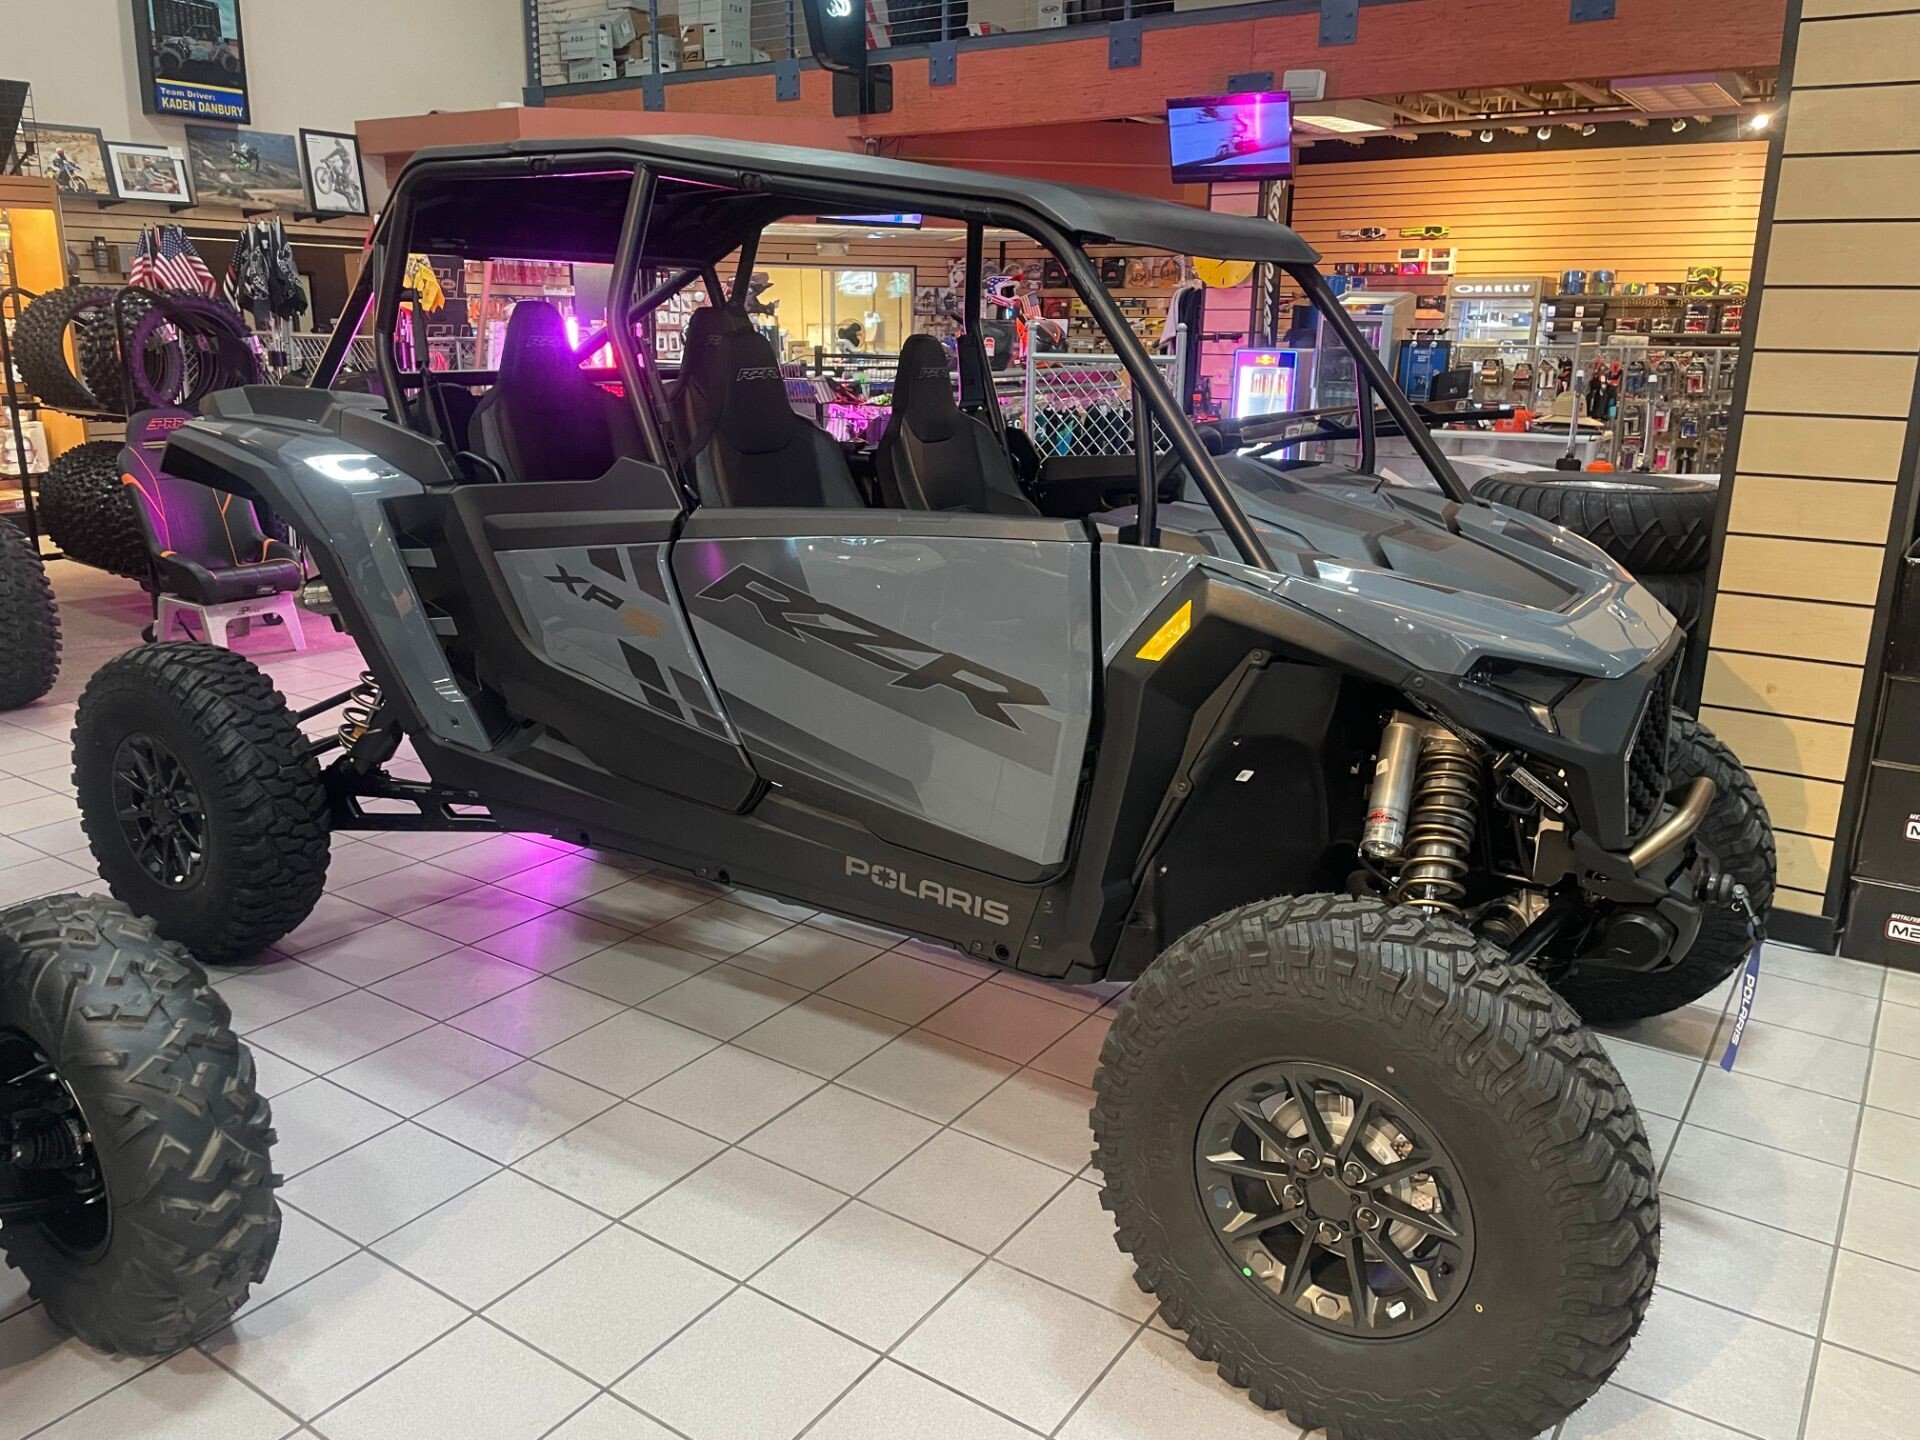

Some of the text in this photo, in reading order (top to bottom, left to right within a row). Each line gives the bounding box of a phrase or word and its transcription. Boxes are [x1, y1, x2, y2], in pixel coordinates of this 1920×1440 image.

[160, 87, 216, 102] Team Driver:
[161, 97, 243, 117] KADEN DANBURY
[736, 366, 779, 381] RZR
[544, 563, 625, 610] XP
[695, 563, 1051, 735] RZR
[845, 855, 1010, 926] POLARIS
[1731, 973, 1756, 1047] POLARIS
